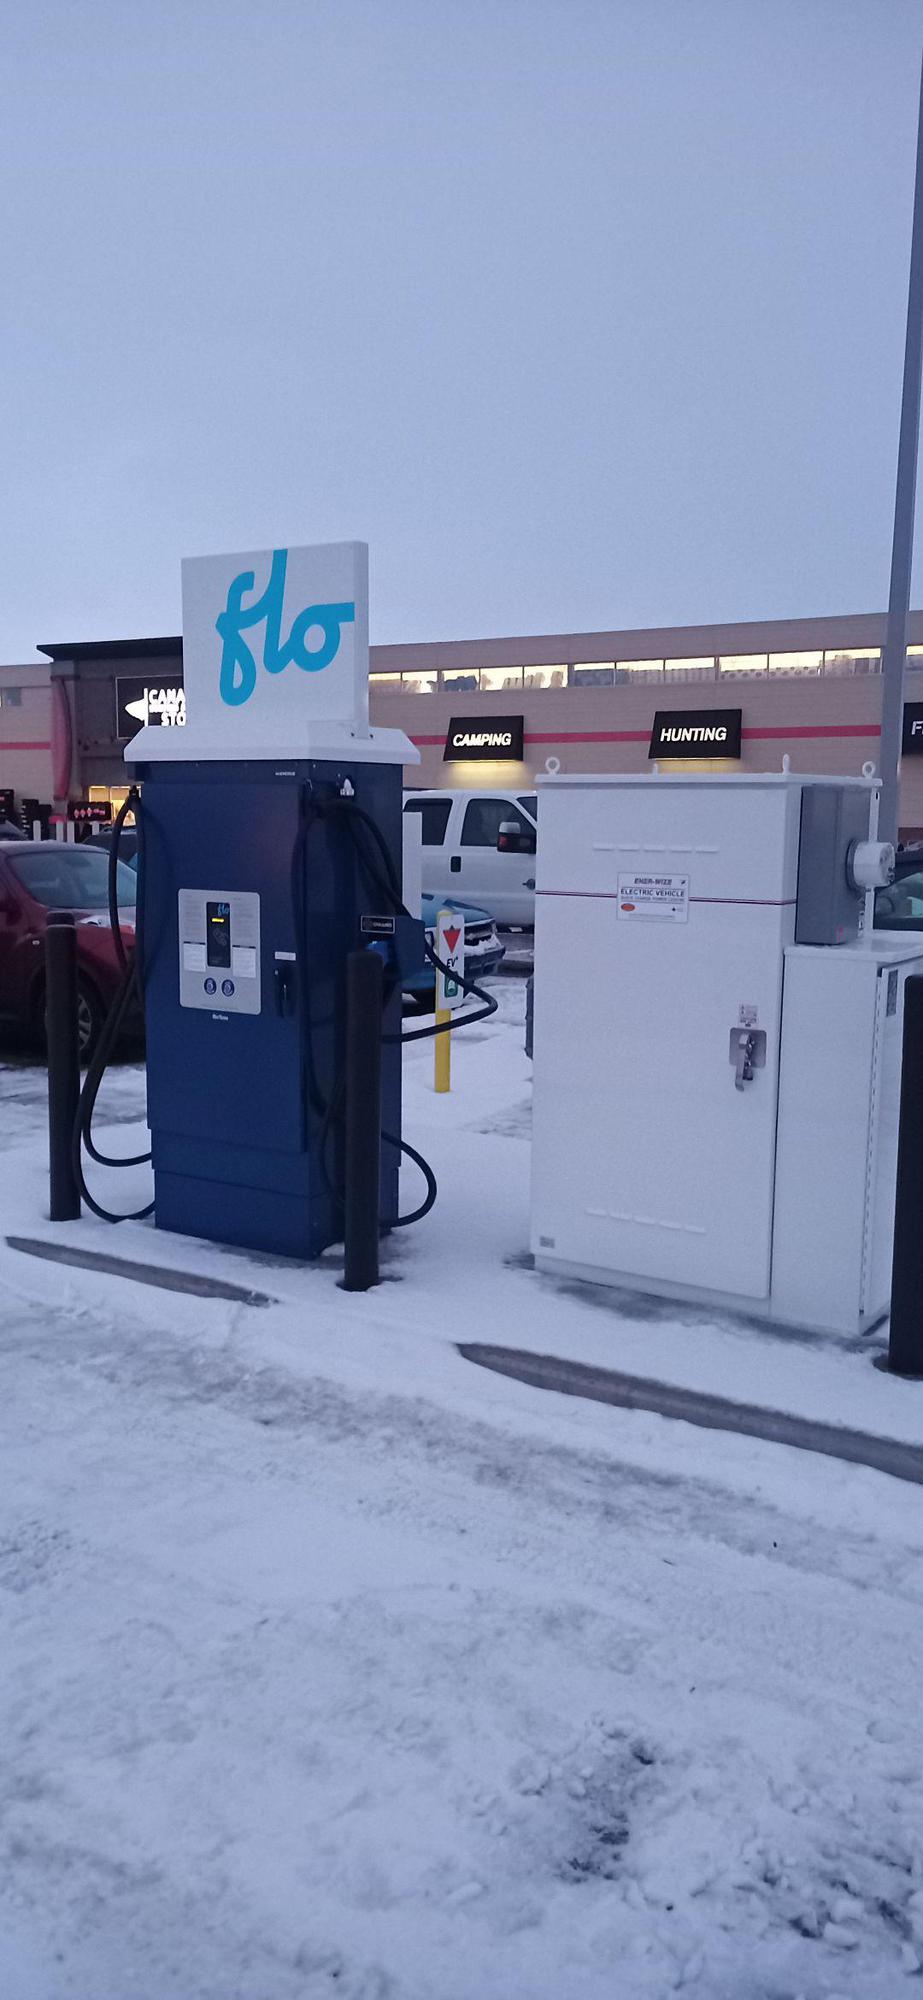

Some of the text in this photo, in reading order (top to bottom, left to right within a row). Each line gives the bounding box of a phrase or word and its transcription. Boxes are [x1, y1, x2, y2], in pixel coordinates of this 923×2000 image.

[215, 549, 355, 706] flo
[453, 733, 512, 747] CAMPING
[660, 727, 727, 742] HUNTING
[621, 888, 685, 897] ELECTRIC VEHICLE
